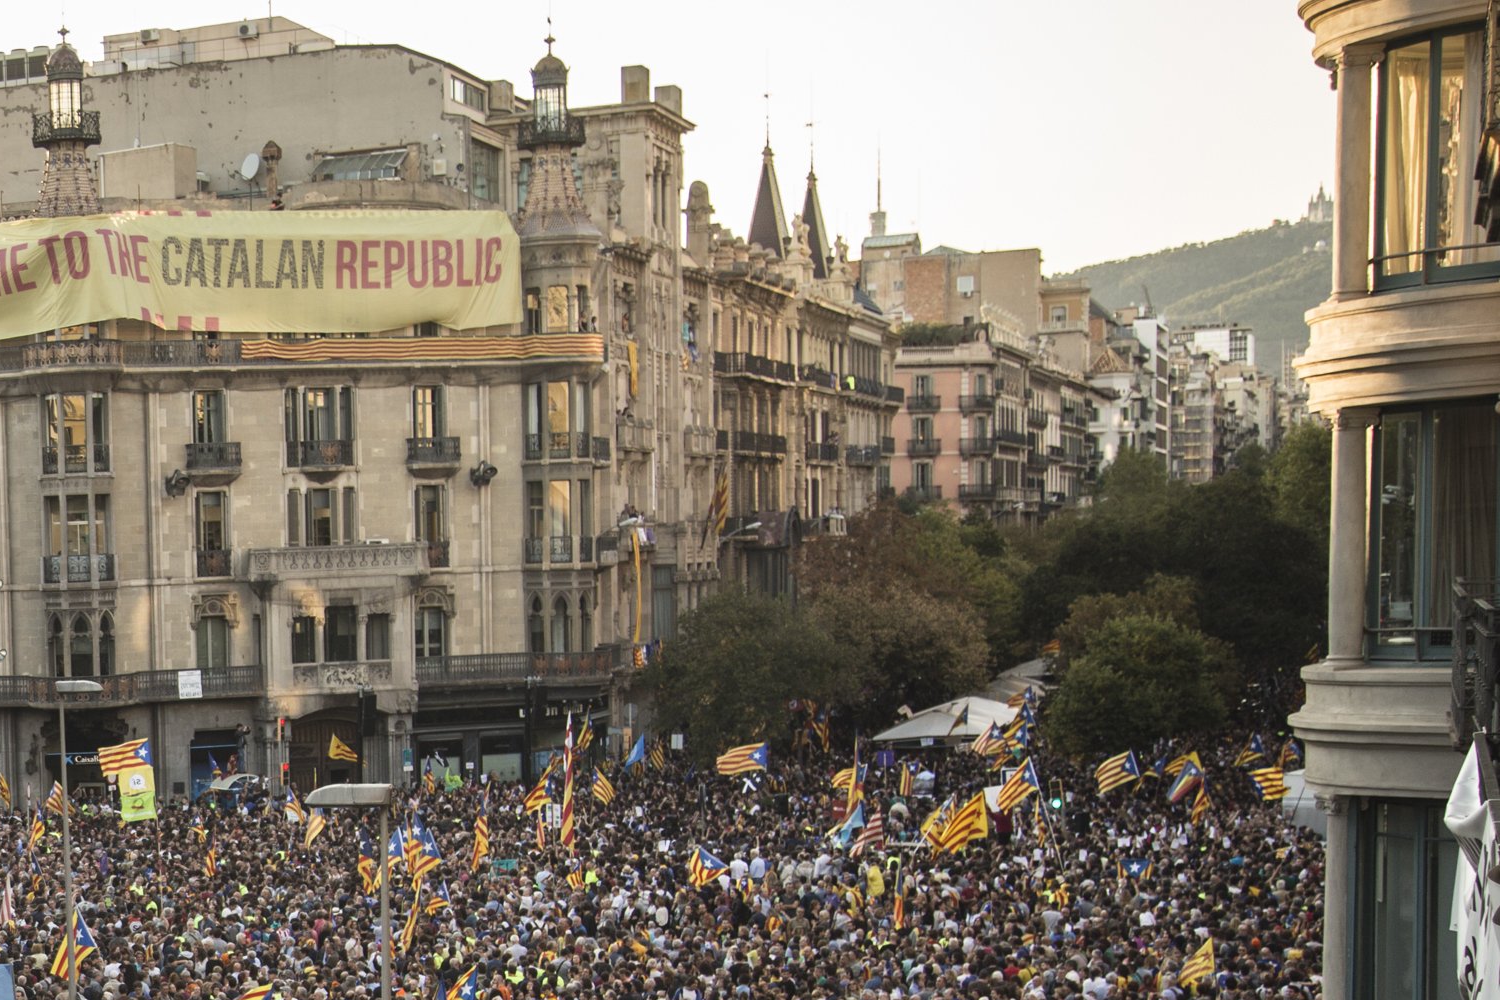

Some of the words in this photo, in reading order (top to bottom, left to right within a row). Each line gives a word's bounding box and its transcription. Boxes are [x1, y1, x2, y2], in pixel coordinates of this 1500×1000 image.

[39, 230, 91, 286] TO
[95, 228, 151, 286] THE
[161, 236, 326, 290] CATALAN
[336, 236, 502, 290] REPUBLIC
[75, 755, 100, 763] CaixaB
